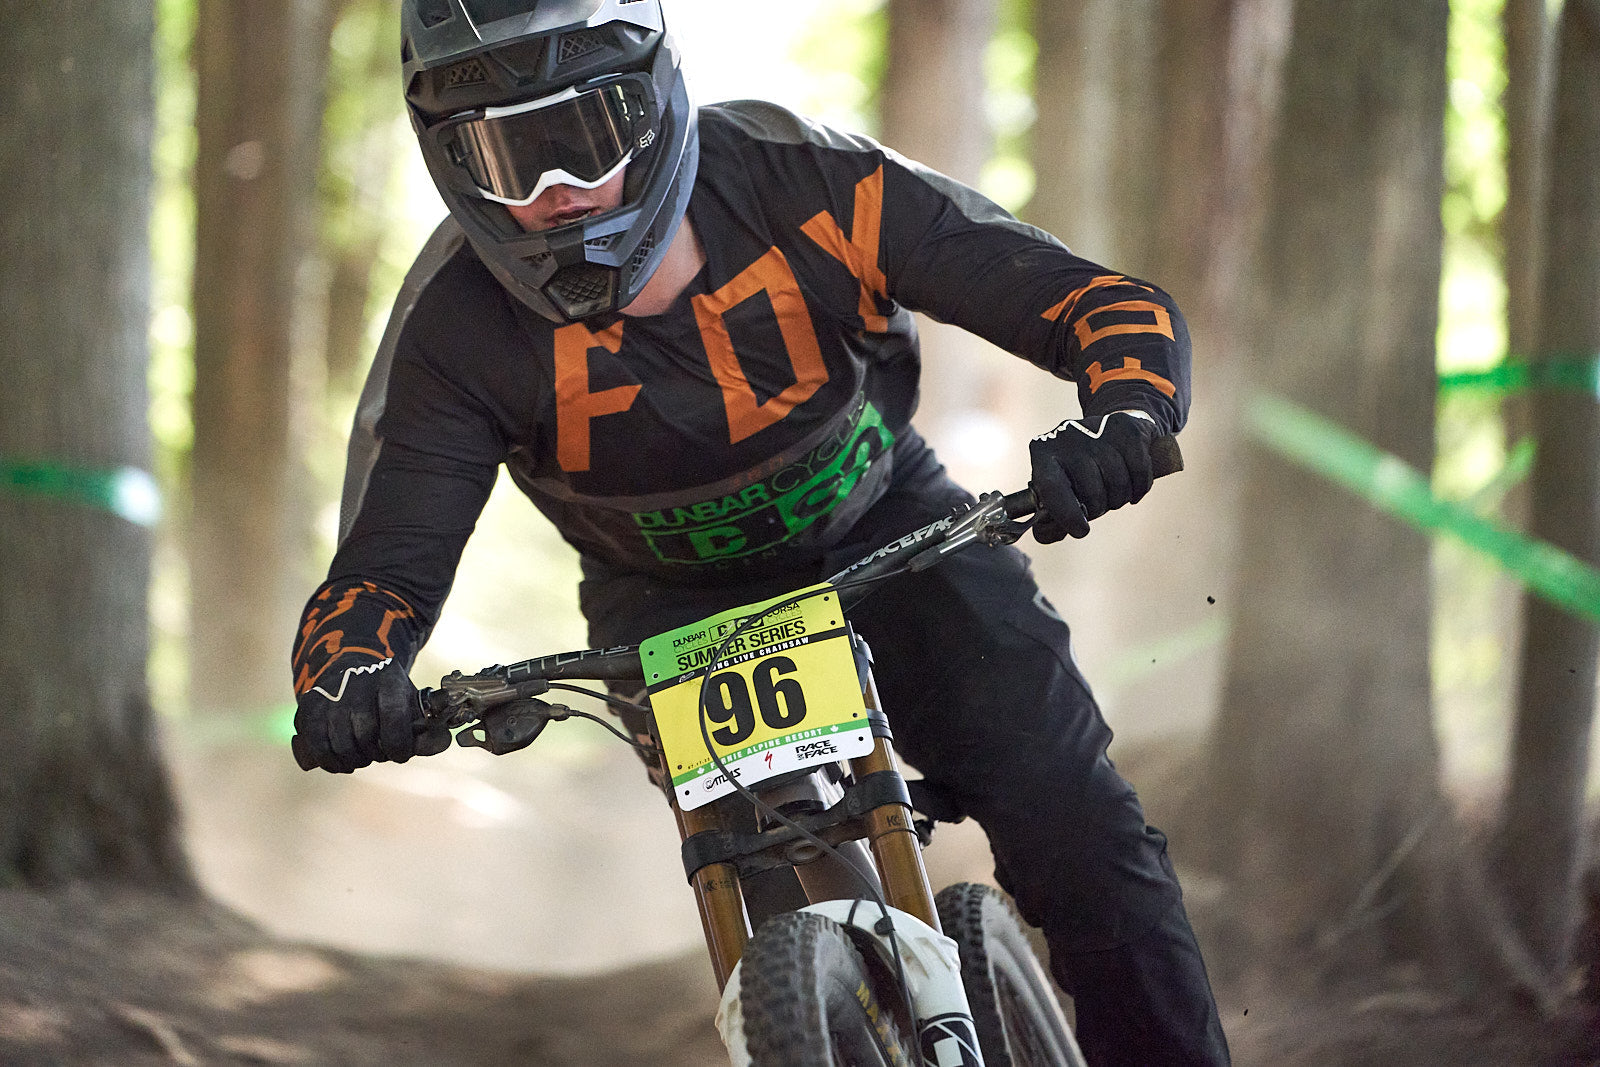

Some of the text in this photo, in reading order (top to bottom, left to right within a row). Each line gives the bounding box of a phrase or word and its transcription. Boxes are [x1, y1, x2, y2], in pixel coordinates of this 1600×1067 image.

[631, 484, 770, 527] DUNBAR
[673, 631, 706, 647] DUNBAR
[677, 620, 806, 671] SUMMER SERIES
[733, 652, 755, 664] LIVE
[760, 637, 809, 656] CHAINSAW
[702, 656, 807, 746] 96
[710, 728, 822, 769] FRNIE ALPINE RESORT
[795, 740, 831, 753] RACE
[804, 746, 838, 759] FACE
